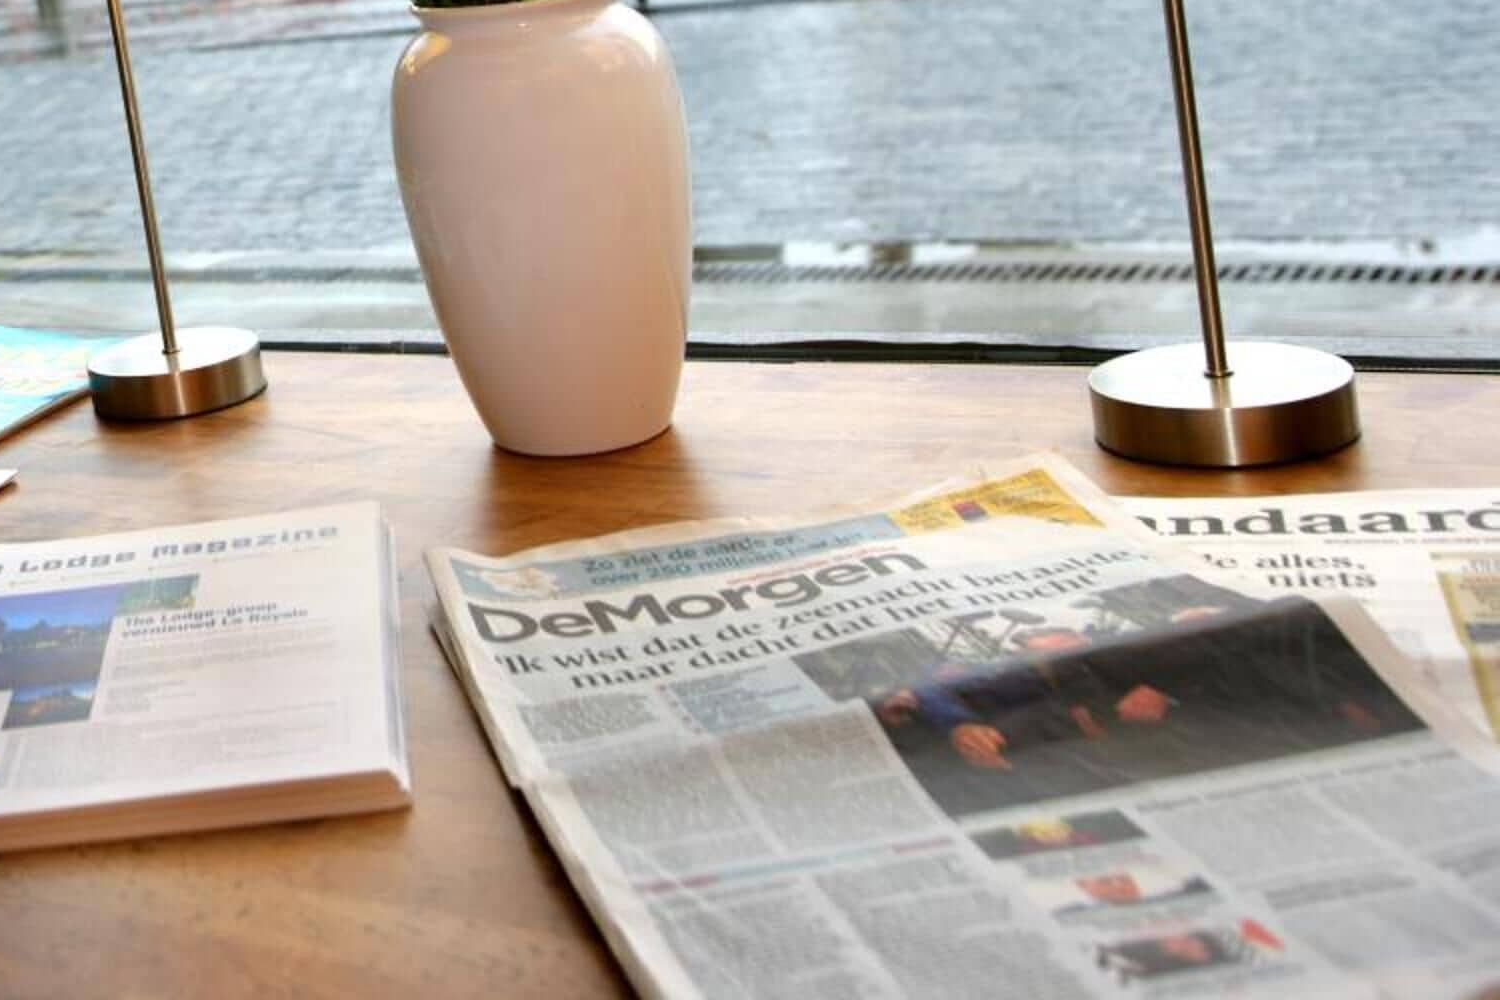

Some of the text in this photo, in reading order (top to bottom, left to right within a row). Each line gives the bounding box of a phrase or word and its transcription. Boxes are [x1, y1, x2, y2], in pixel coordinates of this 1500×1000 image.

[19, 548, 137, 576] Lodge
[151, 523, 340, 558] Magazine
[1266, 572, 1378, 589] niets
[553, 643, 630, 670] wist
[642, 632, 706, 658] dat
[715, 618, 764, 642] de
[570, 660, 676, 690] maar
[688, 630, 804, 670] dacht
[811, 613, 877, 642] dat
[886, 596, 952, 624] het
